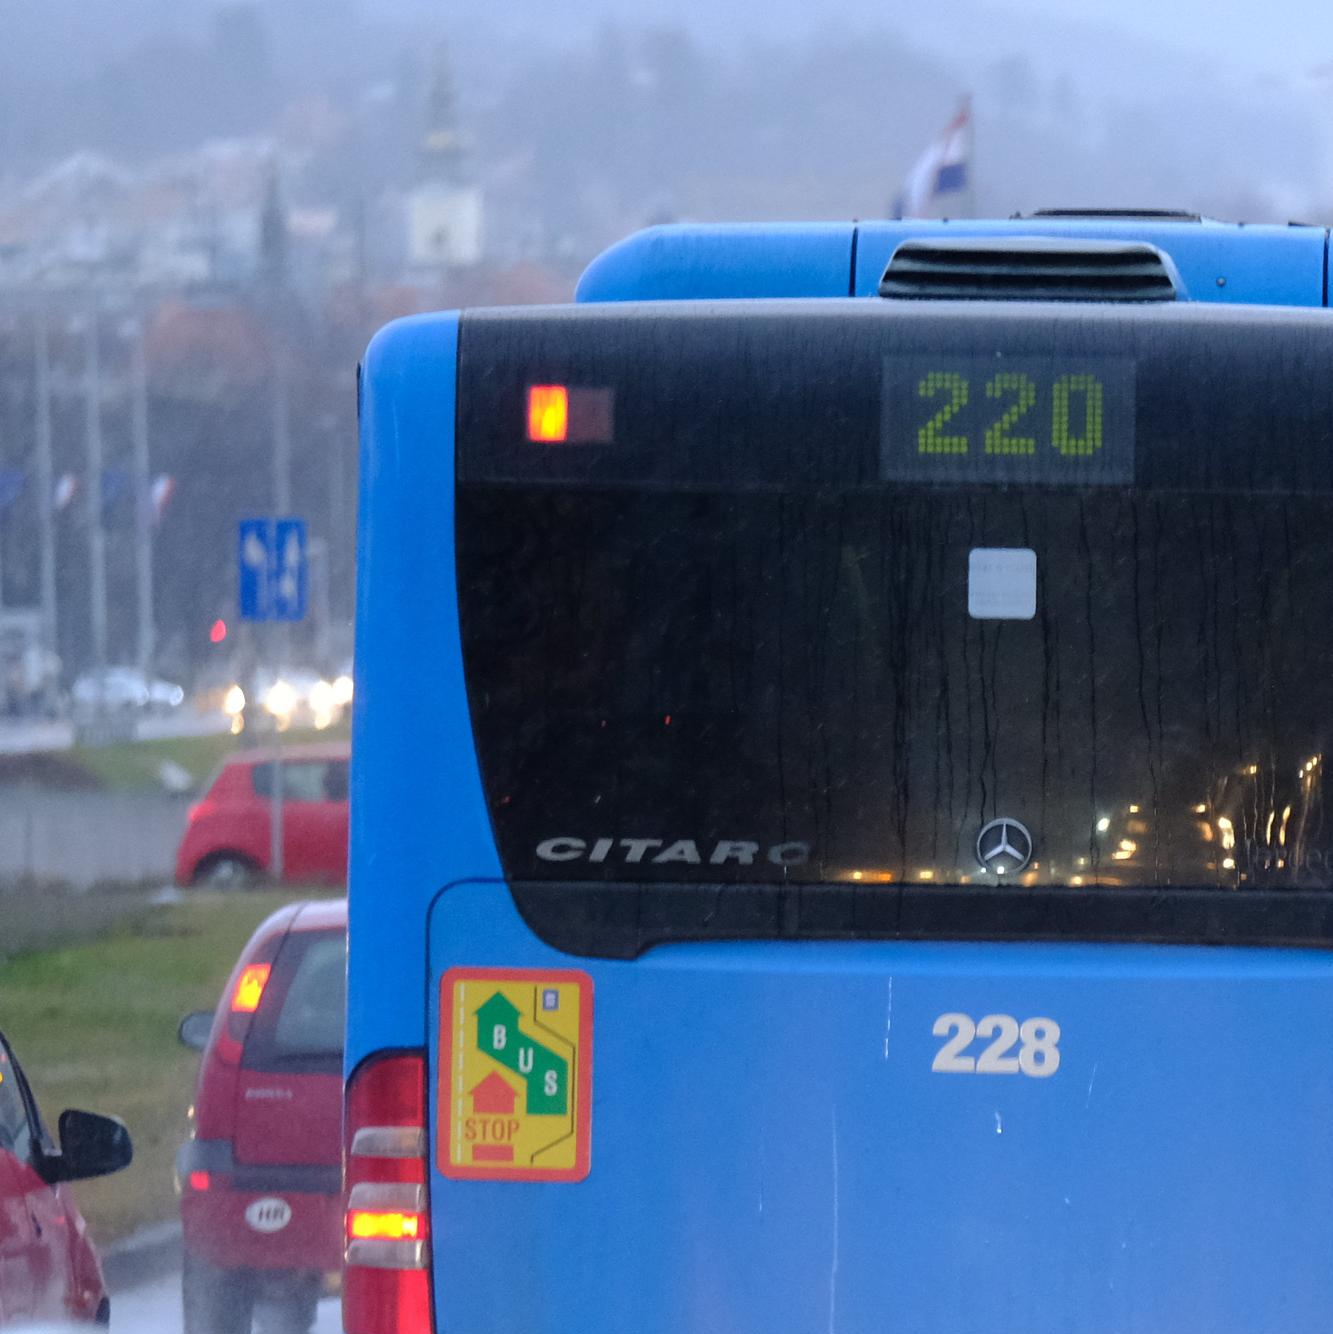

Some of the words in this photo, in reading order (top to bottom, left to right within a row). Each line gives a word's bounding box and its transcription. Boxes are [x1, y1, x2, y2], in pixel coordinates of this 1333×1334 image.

[917, 371, 1103, 457] 220
[536, 837, 810, 865] CITARO
[493, 1024, 559, 1097] BUS
[932, 1012, 1061, 1078] 228
[464, 1118, 520, 1142] STOP
